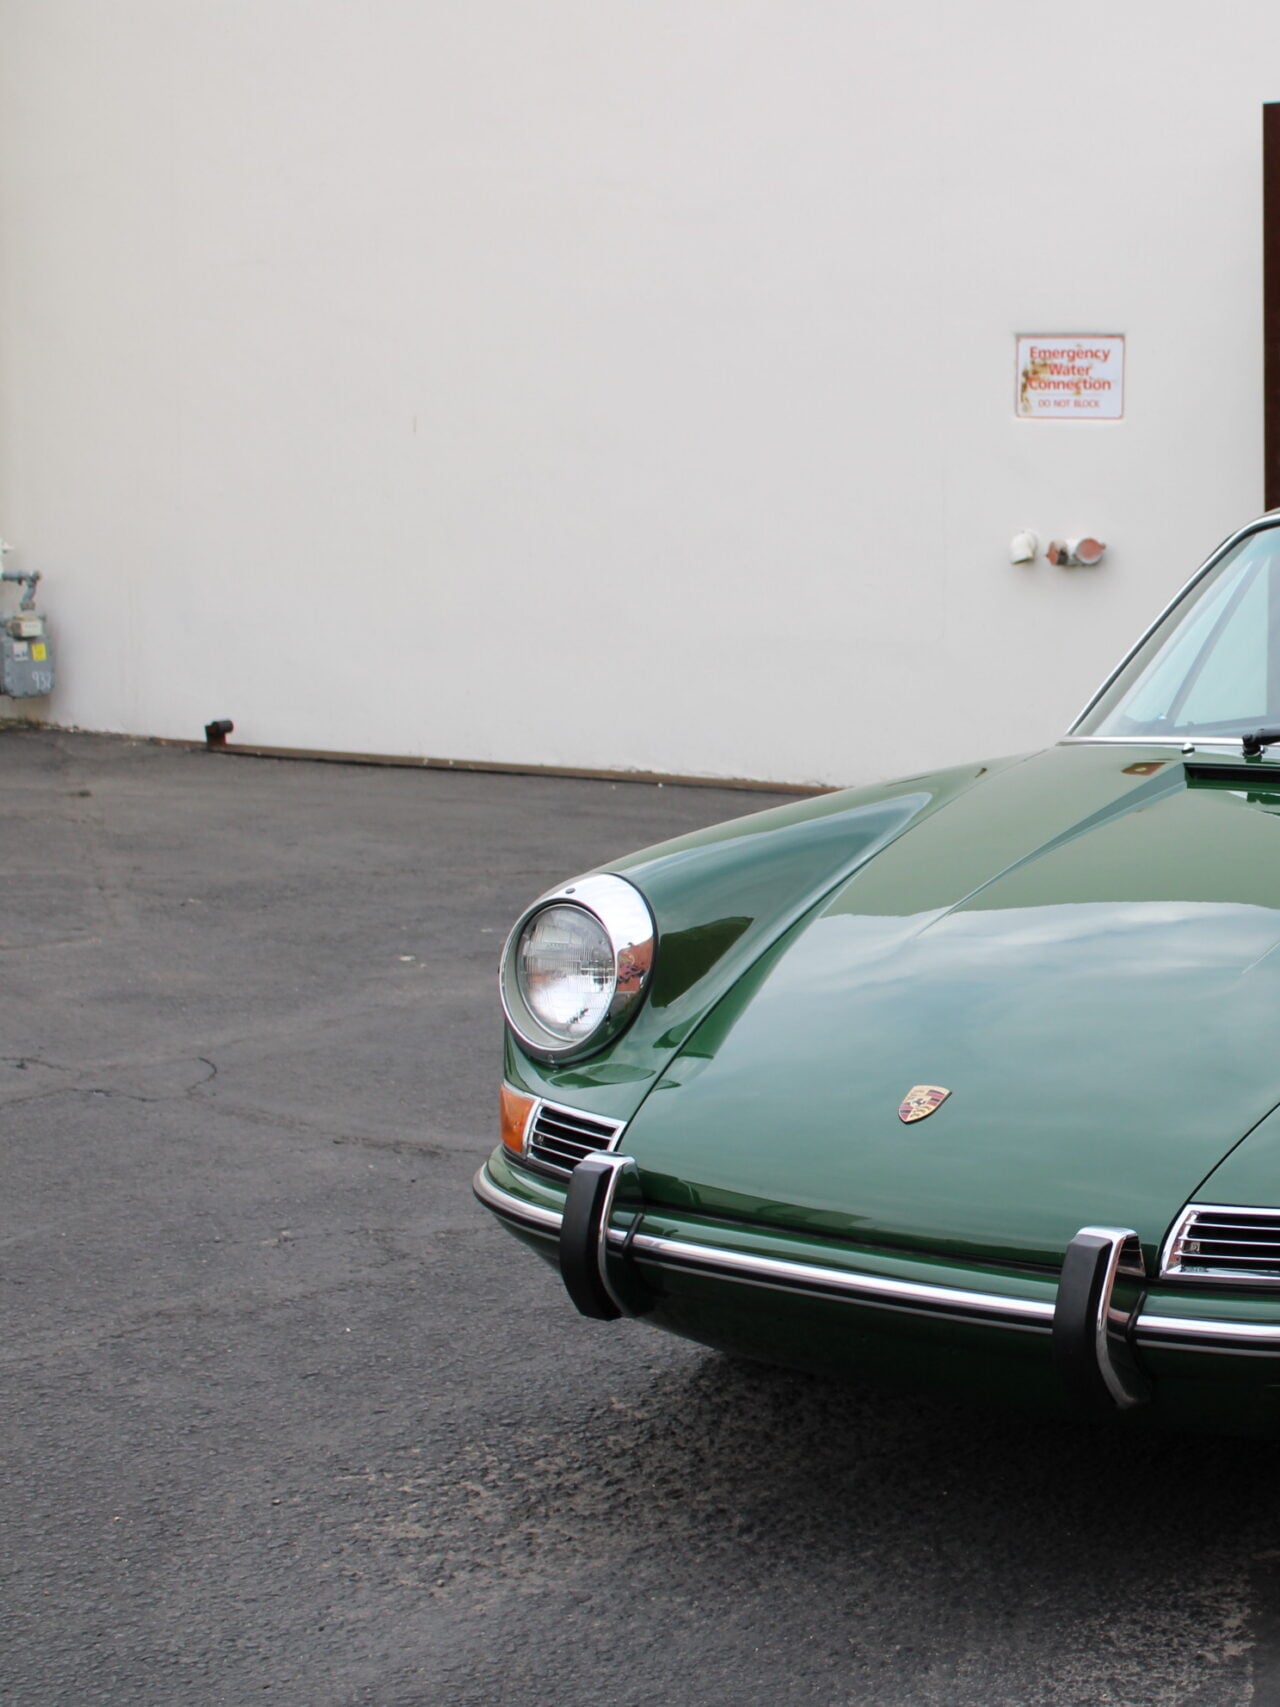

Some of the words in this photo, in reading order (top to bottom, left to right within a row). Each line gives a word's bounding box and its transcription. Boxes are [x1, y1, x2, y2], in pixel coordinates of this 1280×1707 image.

[1029, 345, 1111, 362] Emergency
[1048, 363, 1091, 376] Water
[1027, 378, 1112, 391] Connection
[1038, 399, 1051, 408] DO
[1053, 399, 1070, 408] NOT
[1073, 399, 1100, 408] BLOCK
